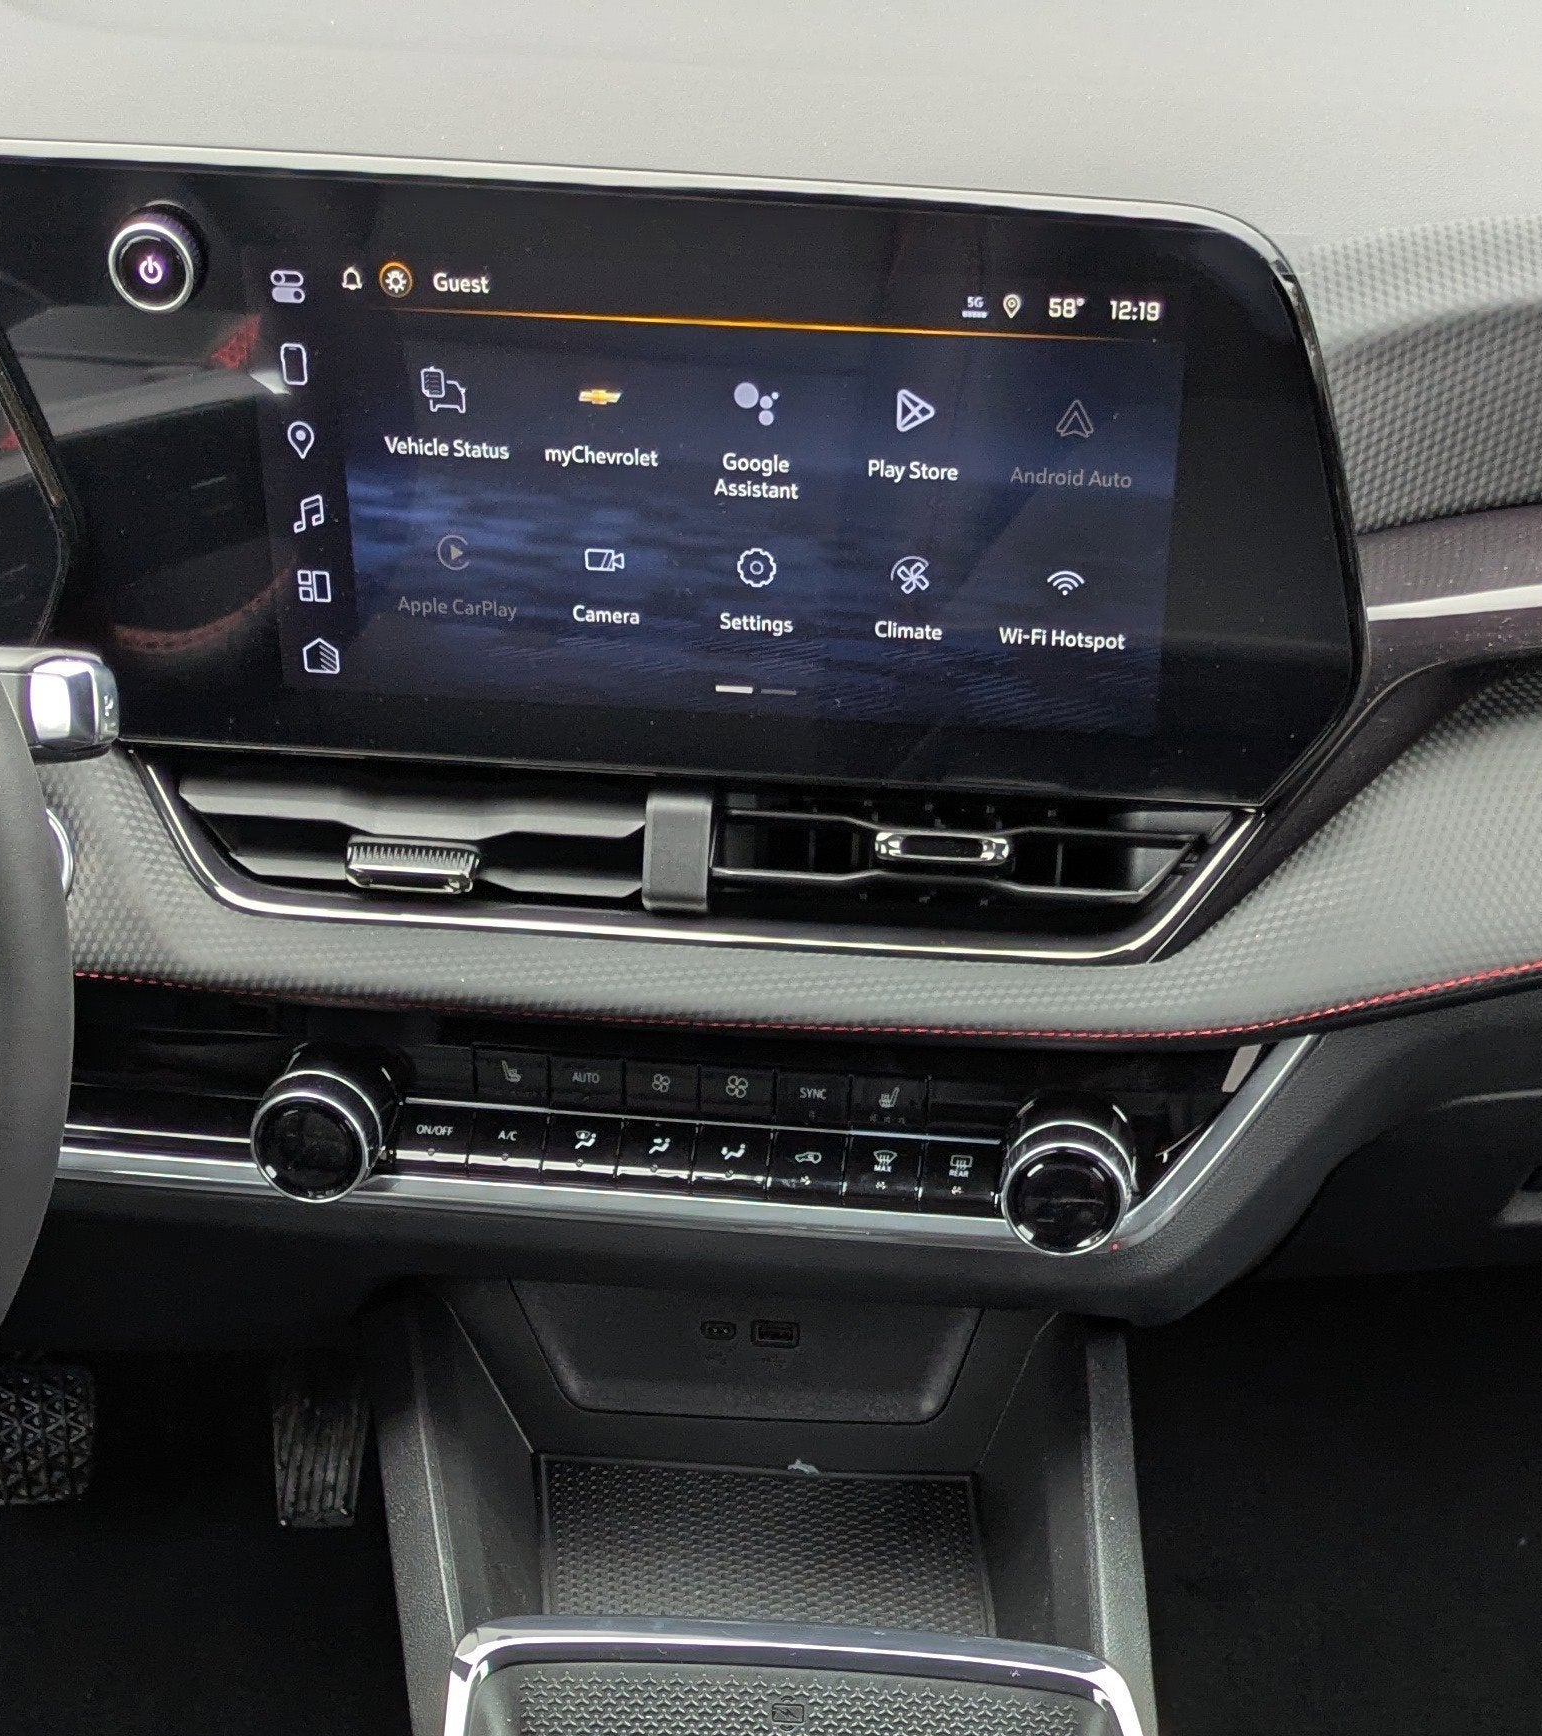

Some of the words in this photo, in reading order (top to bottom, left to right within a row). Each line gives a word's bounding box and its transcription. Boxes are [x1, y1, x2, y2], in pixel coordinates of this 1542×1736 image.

[433, 272, 491, 294] Guest
[967, 297, 984, 308] 5G
[1048, 297, 1085, 319] 58°
[1110, 299, 1161, 322] 12:19
[384, 436, 449, 457] Vehicle
[453, 439, 510, 460] Status
[545, 445, 658, 467] myChevrolet
[722, 452, 790, 477] Google
[868, 459, 905, 483] Play
[909, 461, 959, 481] Store
[1010, 466, 1084, 488] Android
[1089, 469, 1132, 489] Auto
[714, 479, 799, 500] Assistant
[398, 596, 448, 615] Apple
[452, 599, 517, 621] CarPlay
[572, 605, 640, 625] Camera
[720, 613, 793, 636] Settings
[874, 621, 943, 641] Climate
[999, 627, 1047, 646] Wi-Fi
[1051, 631, 1126, 652] Hotspot
[572, 1071, 601, 1084] AUTO
[799, 1086, 828, 1100] SYNC
[416, 1124, 454, 1137] ON/OFF
[497, 1130, 519, 1142] A/C
